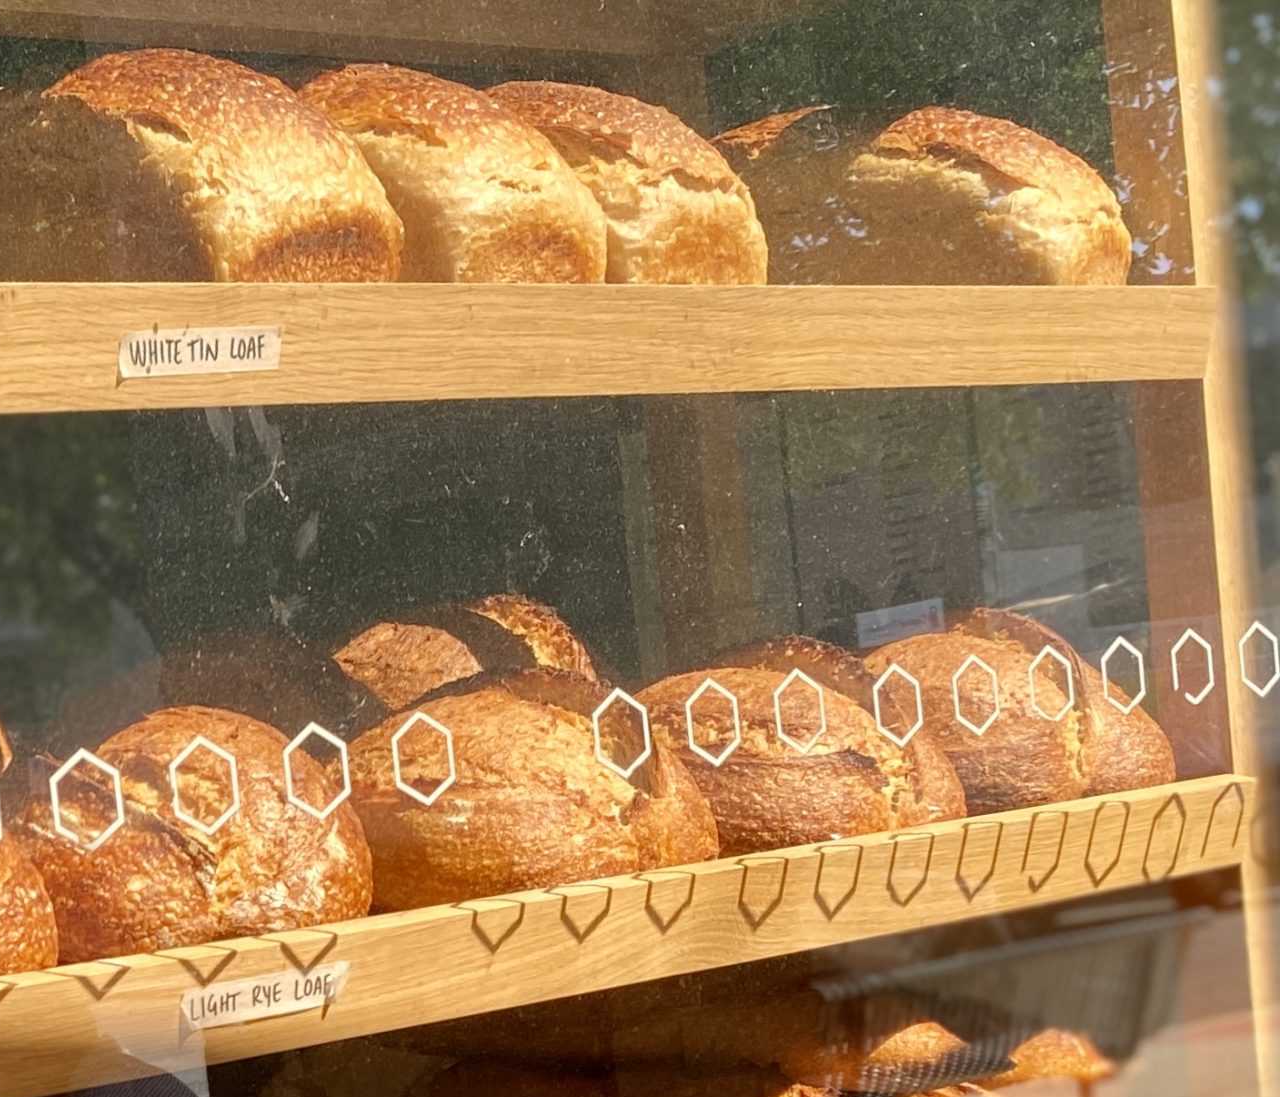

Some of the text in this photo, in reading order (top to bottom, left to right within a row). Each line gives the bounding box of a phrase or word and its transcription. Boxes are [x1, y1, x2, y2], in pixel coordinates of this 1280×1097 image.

[129, 334, 265, 367] WHITE TIN LOAF
[190, 973, 332, 1021] LIGHT RYE LOAF
